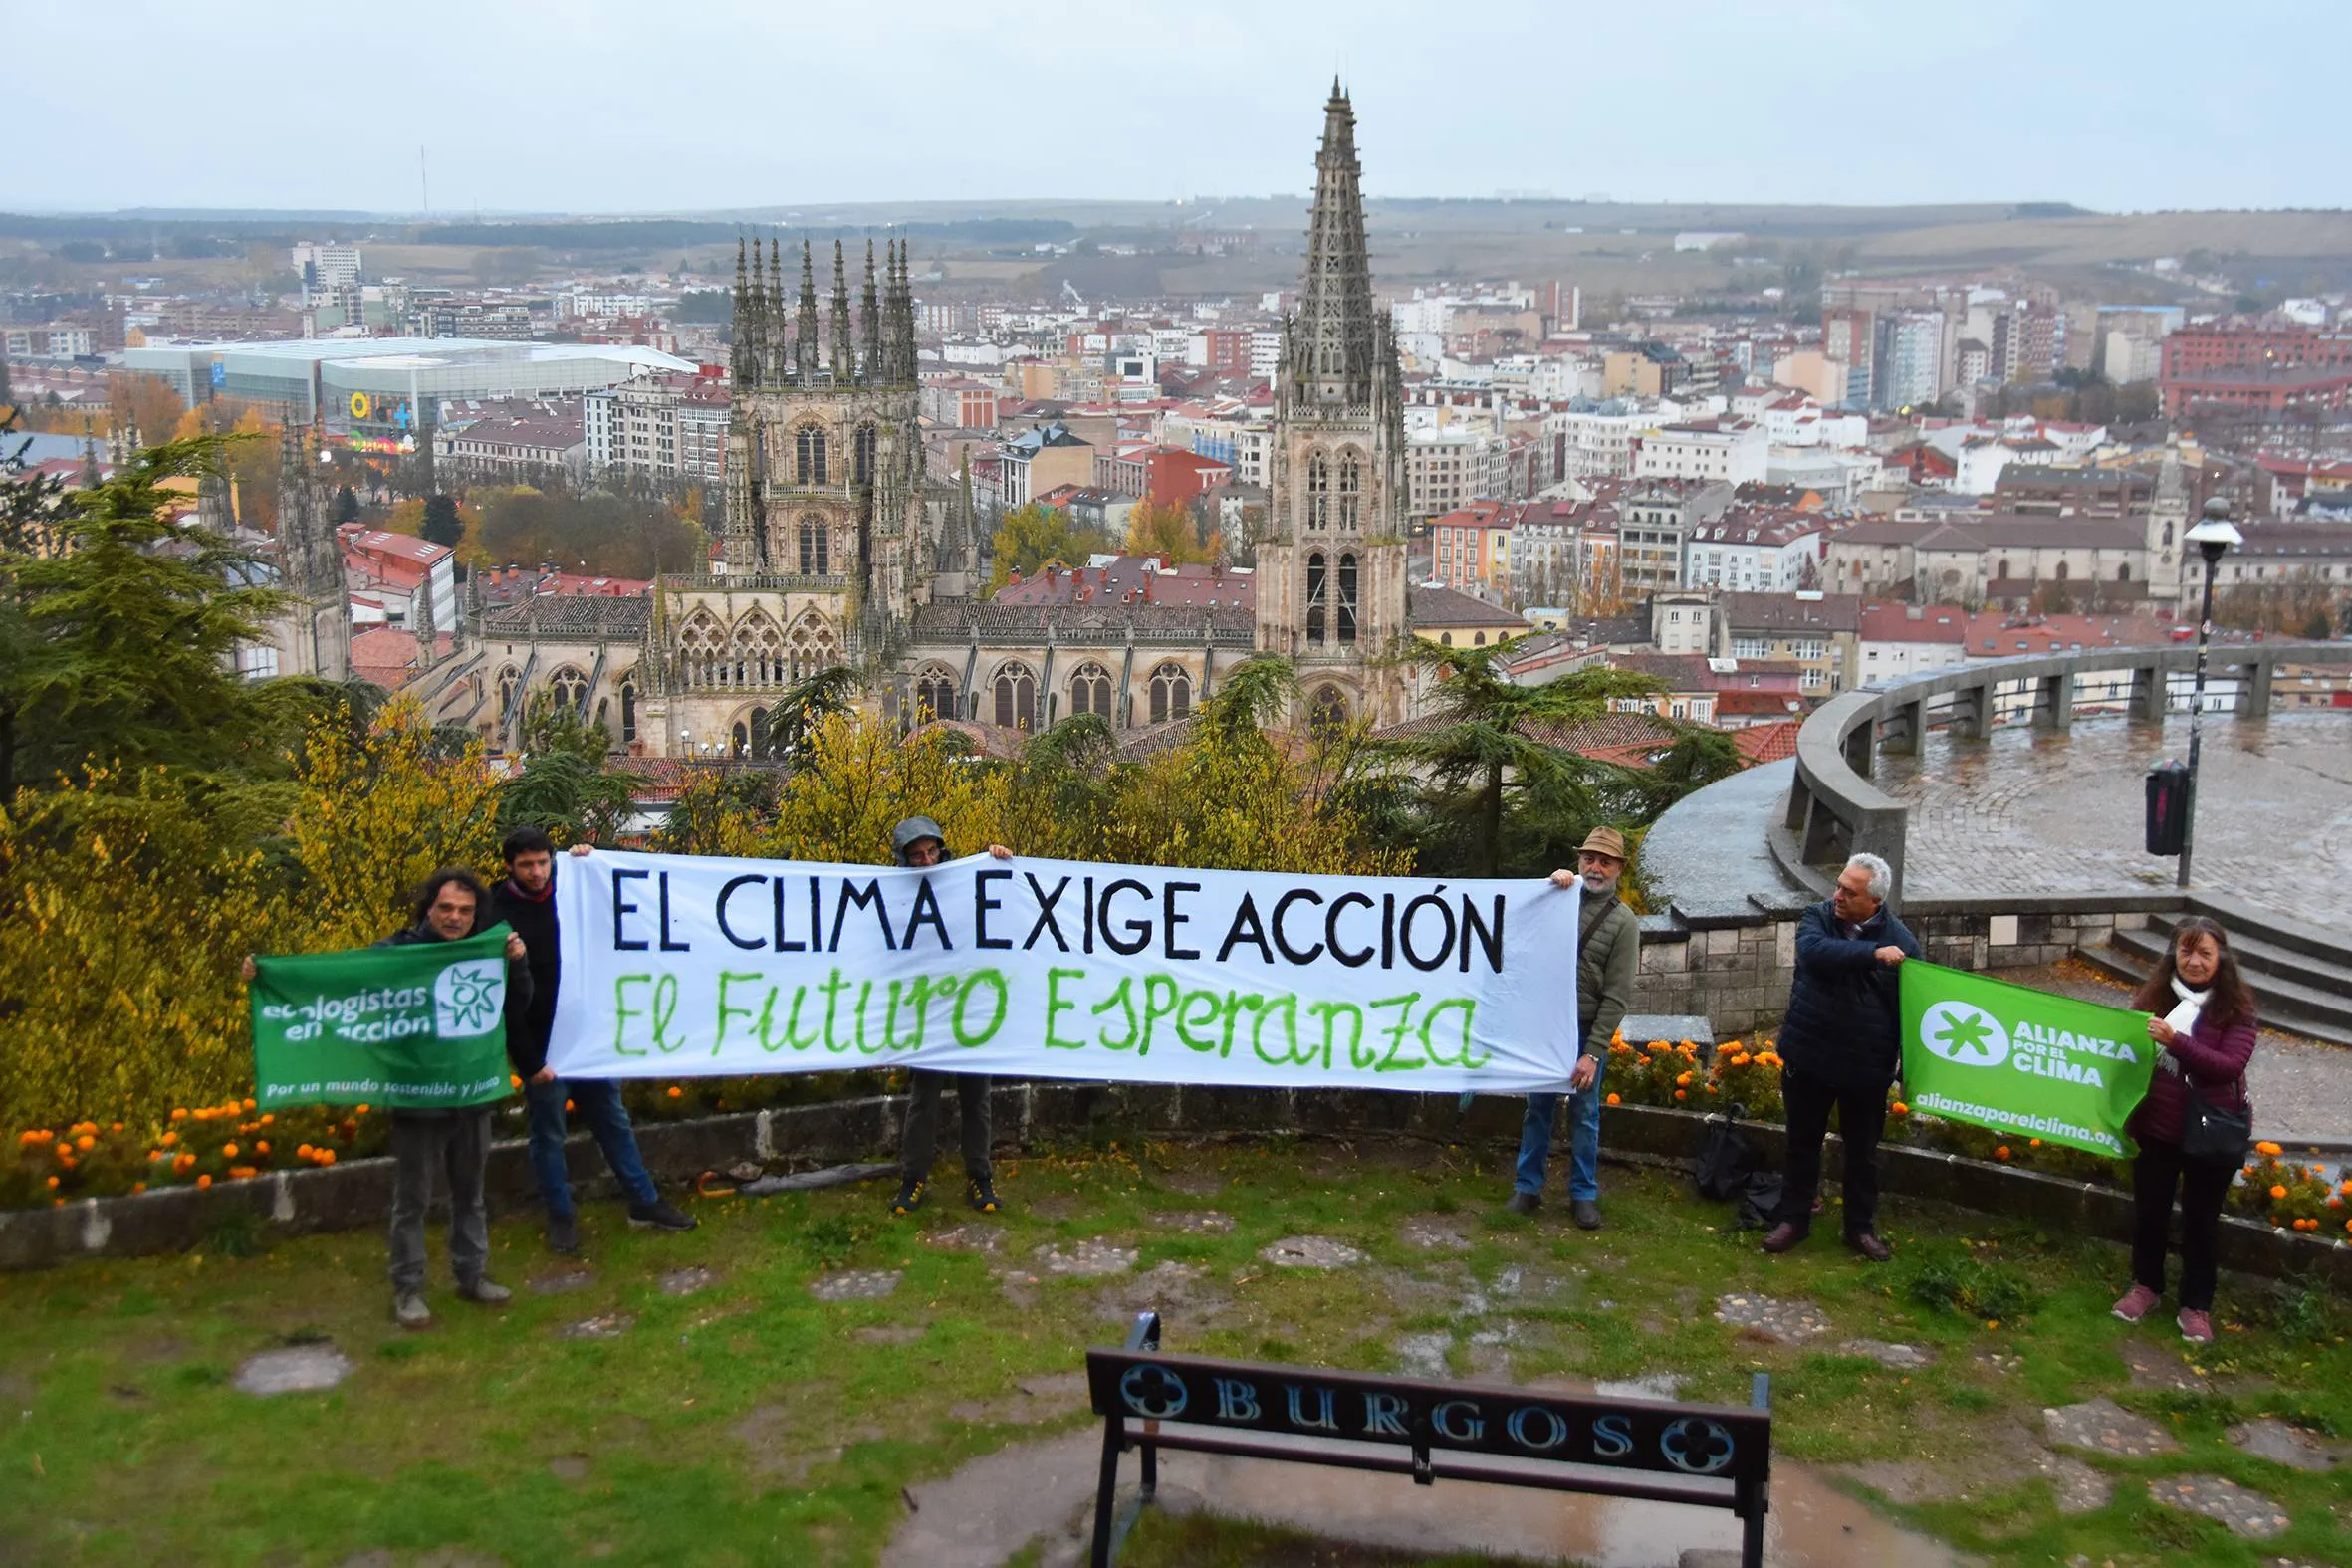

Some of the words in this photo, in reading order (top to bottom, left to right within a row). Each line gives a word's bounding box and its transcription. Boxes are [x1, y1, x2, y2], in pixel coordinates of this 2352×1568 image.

[611, 869, 691, 953] EL
[716, 873, 953, 953] CLIMA
[975, 868, 1201, 961] EXIGE
[1216, 884, 1506, 974] ACCIÓN
[285, 1021, 323, 1042] en
[614, 973, 686, 1056] El
[2012, 1021, 2138, 1064] ALIANZA
[2012, 1039, 2048, 1056] POR
[2050, 1046, 2068, 1060] EL
[267, 1083, 296, 1097] Por
[301, 1082, 320, 1093] un
[326, 1078, 379, 1093] mundo
[384, 1081, 457, 1096] sostenible
[461, 1085, 471, 1098] y
[2012, 1052, 2104, 1088] CLIMA
[1213, 1377, 1634, 1457] BURGOS
